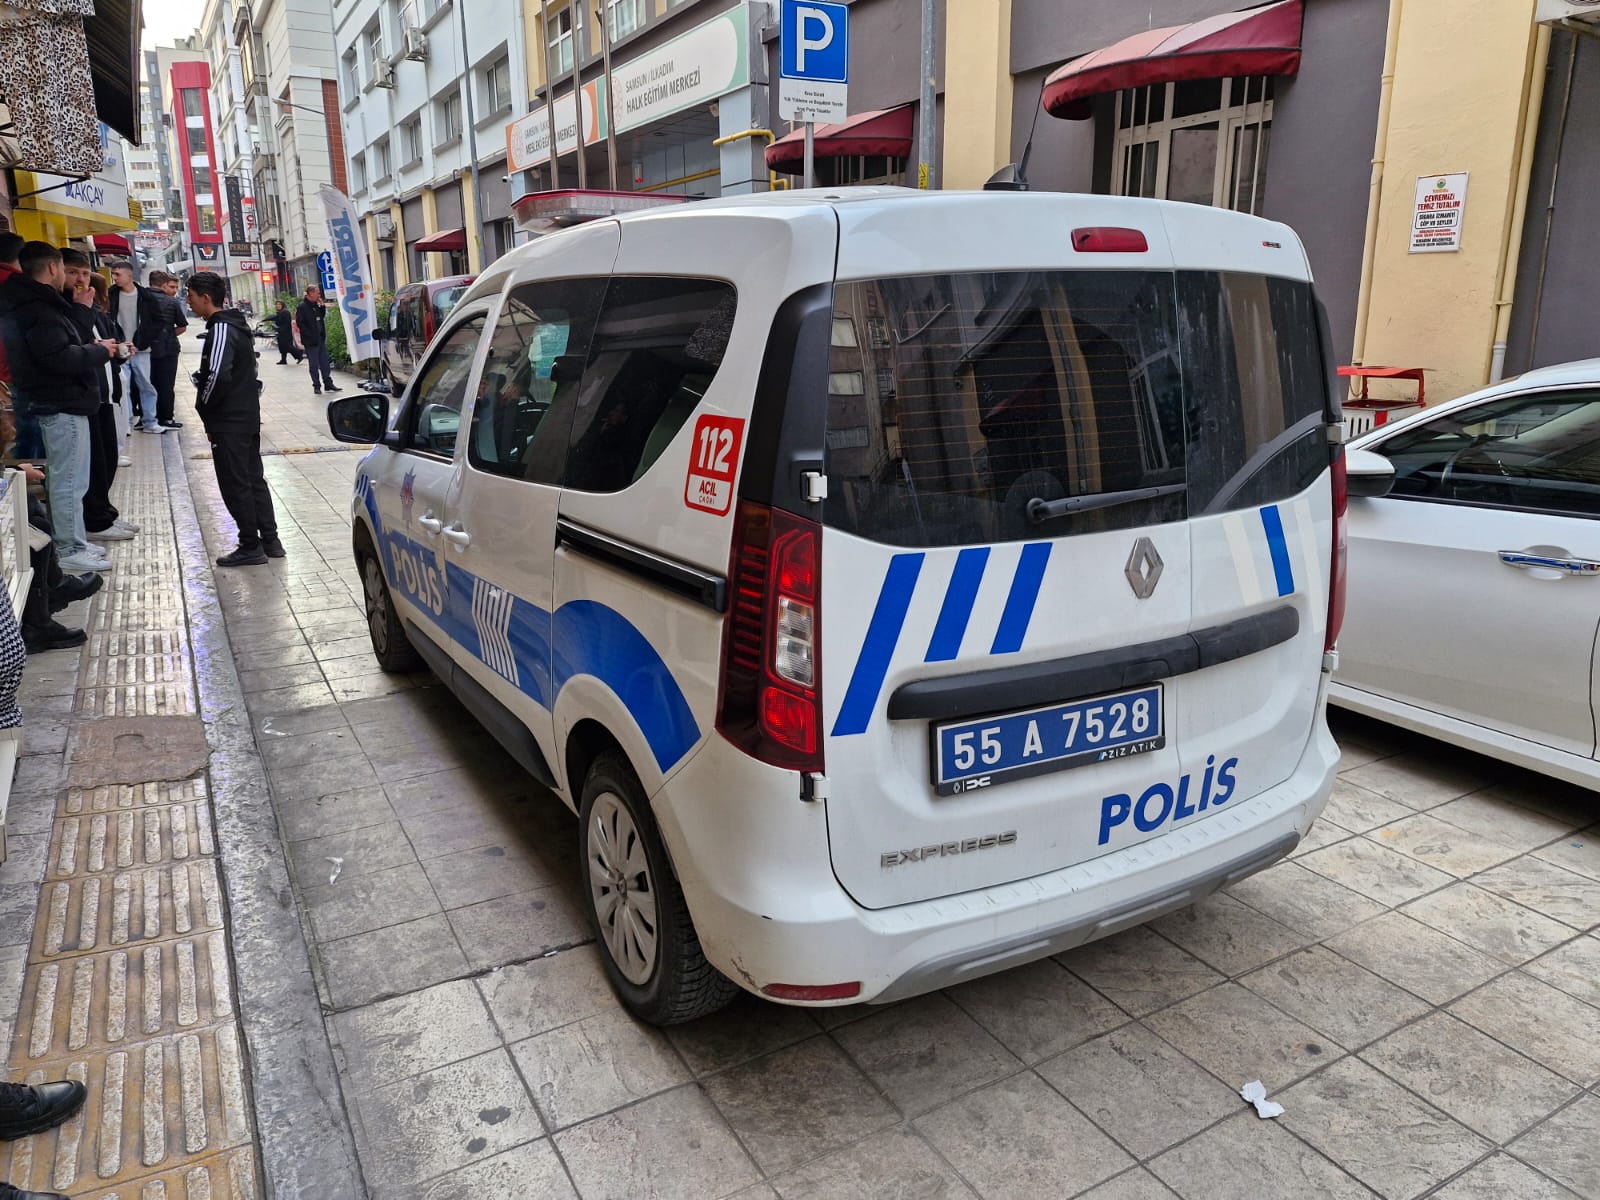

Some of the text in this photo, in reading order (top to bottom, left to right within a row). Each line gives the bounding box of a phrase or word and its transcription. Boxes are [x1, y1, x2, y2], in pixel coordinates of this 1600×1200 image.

[796, 6, 834, 72] P
[626, 95, 644, 115] HALK
[669, 65, 701, 96] MERKEZİ
[75, 183, 104, 207] AKÇAY
[698, 426, 734, 473] 112
[389, 540, 443, 617] POLİS
[953, 698, 1149, 770] 55 A 7528
[1097, 754, 1239, 846] POLİS
[880, 830, 1018, 868] EXPRESS
